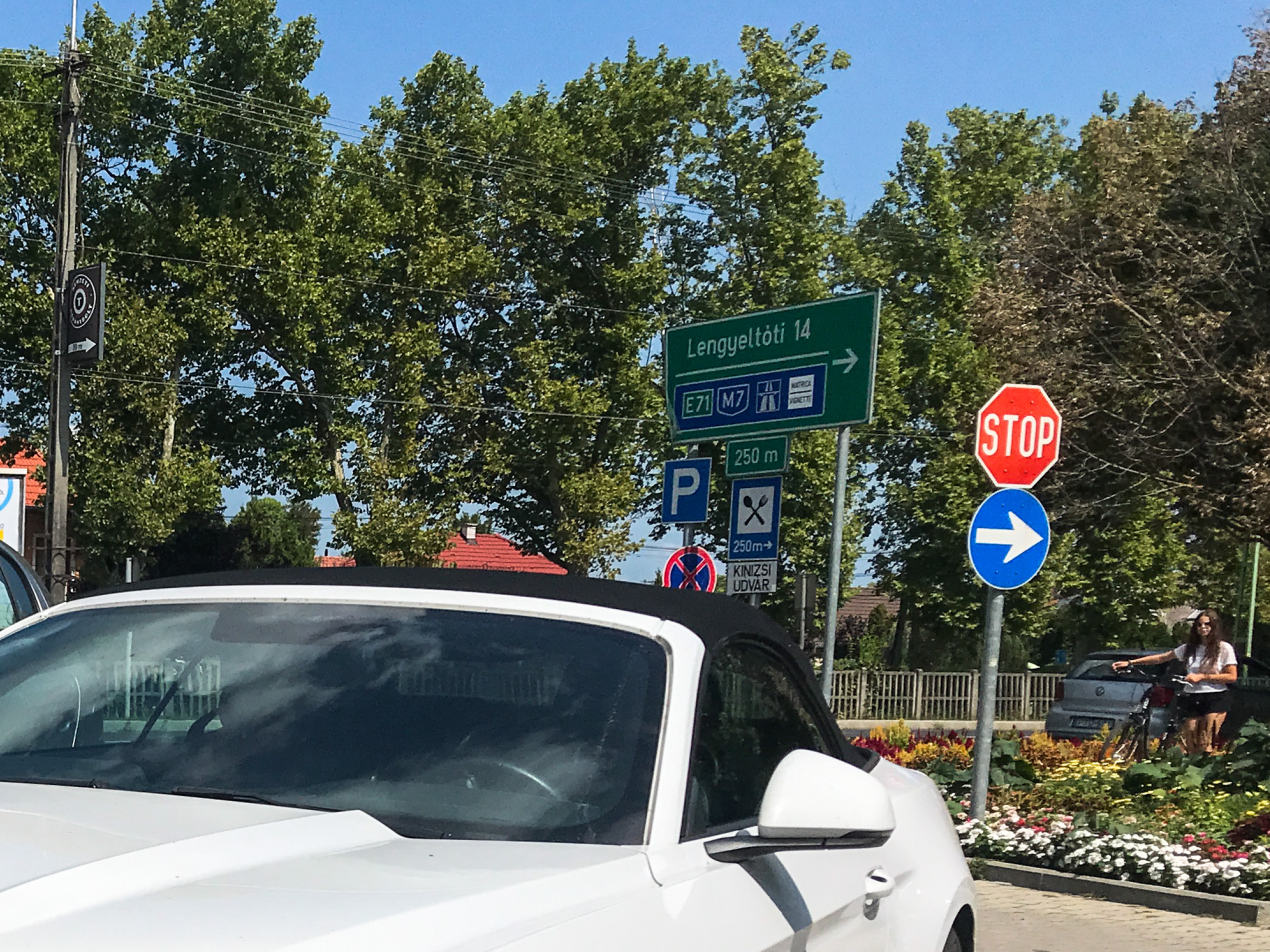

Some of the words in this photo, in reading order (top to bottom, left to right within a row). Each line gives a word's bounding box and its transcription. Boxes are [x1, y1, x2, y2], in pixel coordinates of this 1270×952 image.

[688, 322, 785, 358] Lengyeltóti
[794, 317, 811, 341] 14
[685, 394, 710, 414] E71
[722, 390, 745, 409] M7
[982, 413, 1055, 459] STOP
[734, 447, 759, 466] 250
[764, 450, 777, 462] m
[671, 468, 700, 515] P
[733, 540, 763, 553] 250m
[733, 563, 771, 577] KINIZSI
